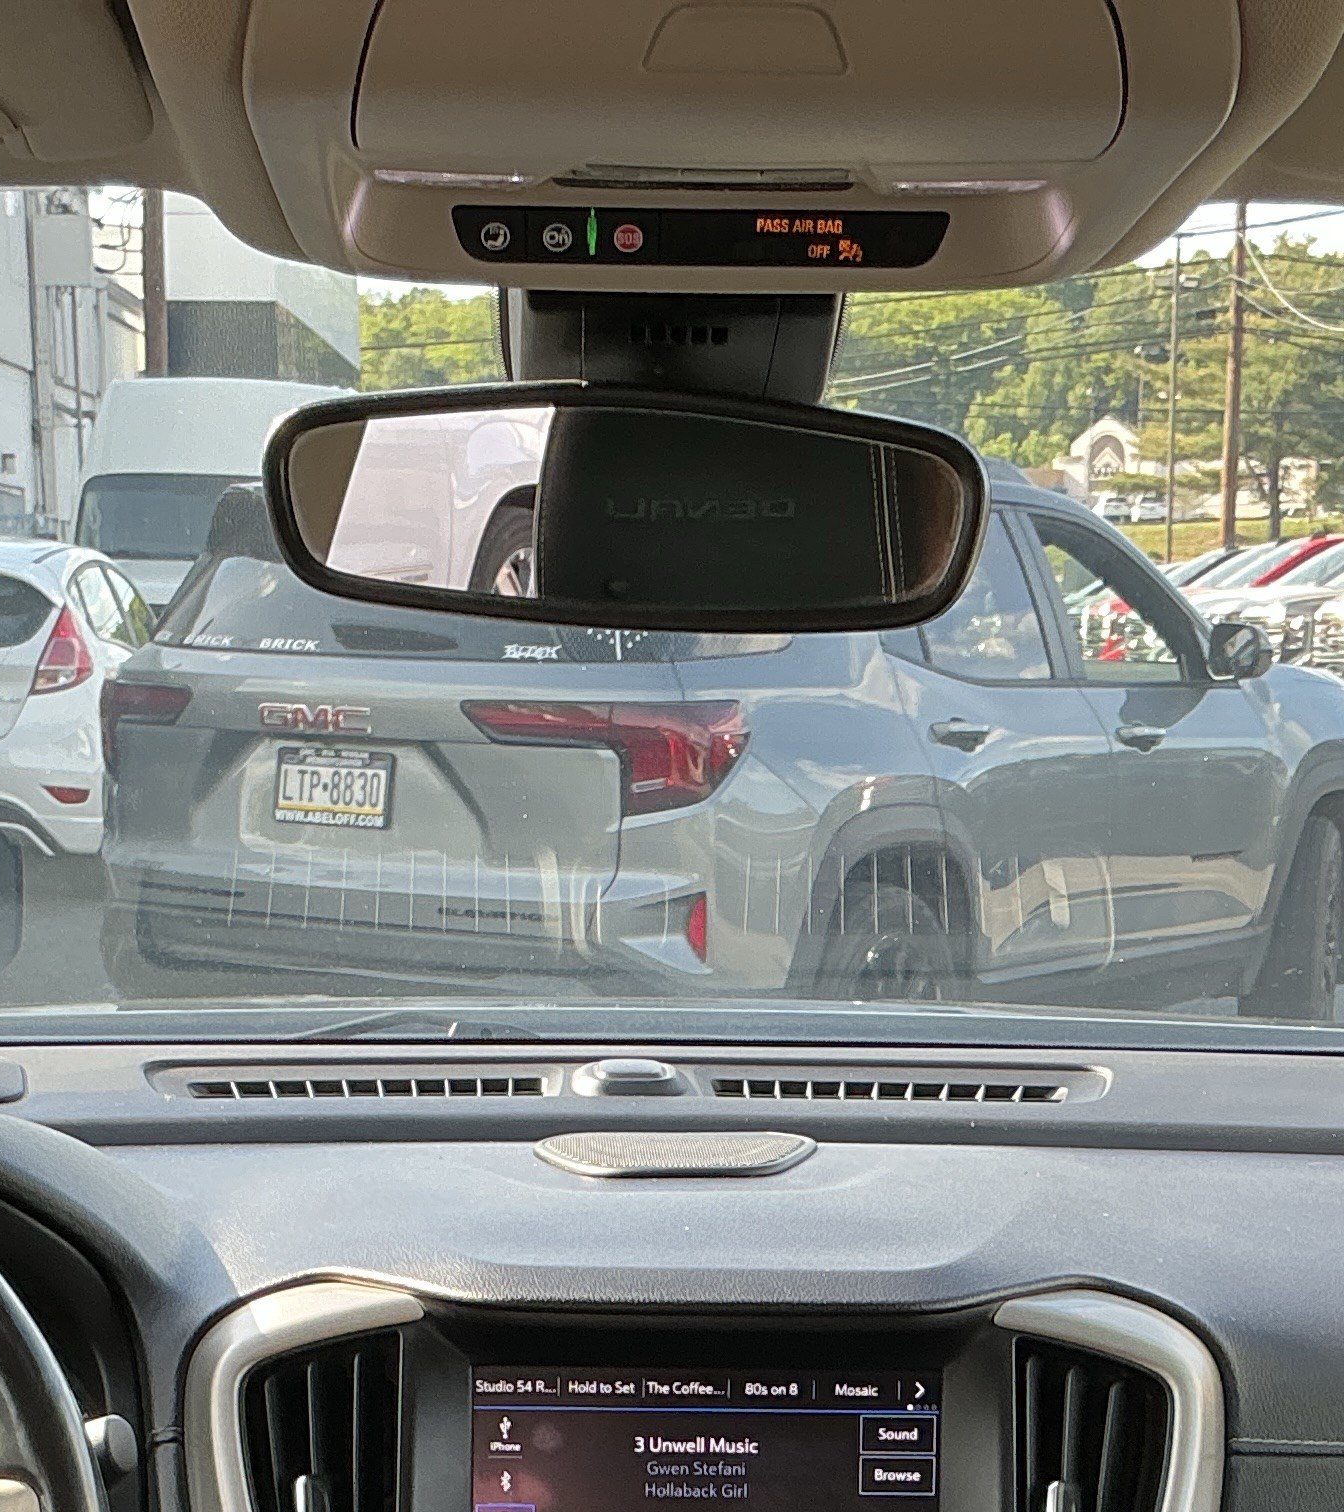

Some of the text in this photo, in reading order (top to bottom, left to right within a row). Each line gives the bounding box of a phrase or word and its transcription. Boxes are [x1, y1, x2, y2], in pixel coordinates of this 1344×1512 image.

[756, 217, 844, 235] PASS AIR BAG
[617, 229, 641, 246] SOS
[807, 244, 831, 260] OFF
[258, 636, 321, 653] BRICK
[257, 702, 372, 735] GMC
[475, 1379, 515, 1394] Studio
[517, 1380, 534, 1394] 54
[567, 1380, 636, 1395] Hold to Set
[647, 1381, 669, 1395] The
[744, 1382, 799, 1397] 80s on 8
[834, 1382, 879, 1397] Mosaic
[877, 1426, 919, 1442] Sound
[489, 1440, 522, 1453] iPhone
[633, 1437, 760, 1454] 3 Unwell Music
[646, 1461, 747, 1477] Gwen Stefani
[873, 1467, 922, 1483] Browse
[644, 1483, 750, 1499] Hollaback Girl
